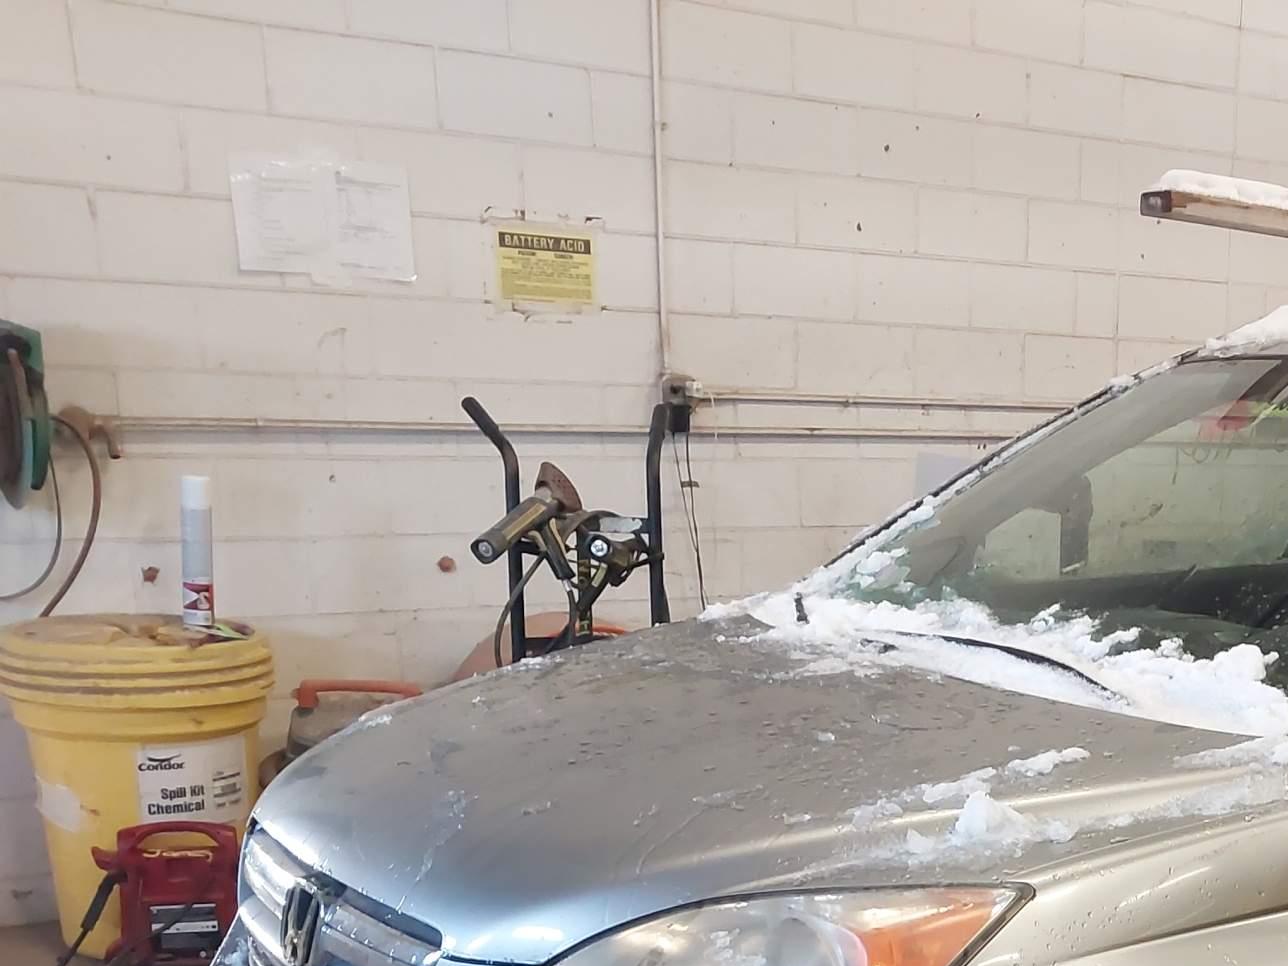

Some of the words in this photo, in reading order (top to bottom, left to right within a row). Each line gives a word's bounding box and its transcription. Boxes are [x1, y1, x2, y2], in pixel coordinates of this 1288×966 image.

[504, 234, 554, 250] BATTERY
[559, 239, 585, 252] ACID
[138, 760, 185, 772] Condor
[160, 786, 187, 800] Spill
[190, 784, 205, 797] Kit
[148, 800, 205, 815] Chemical
